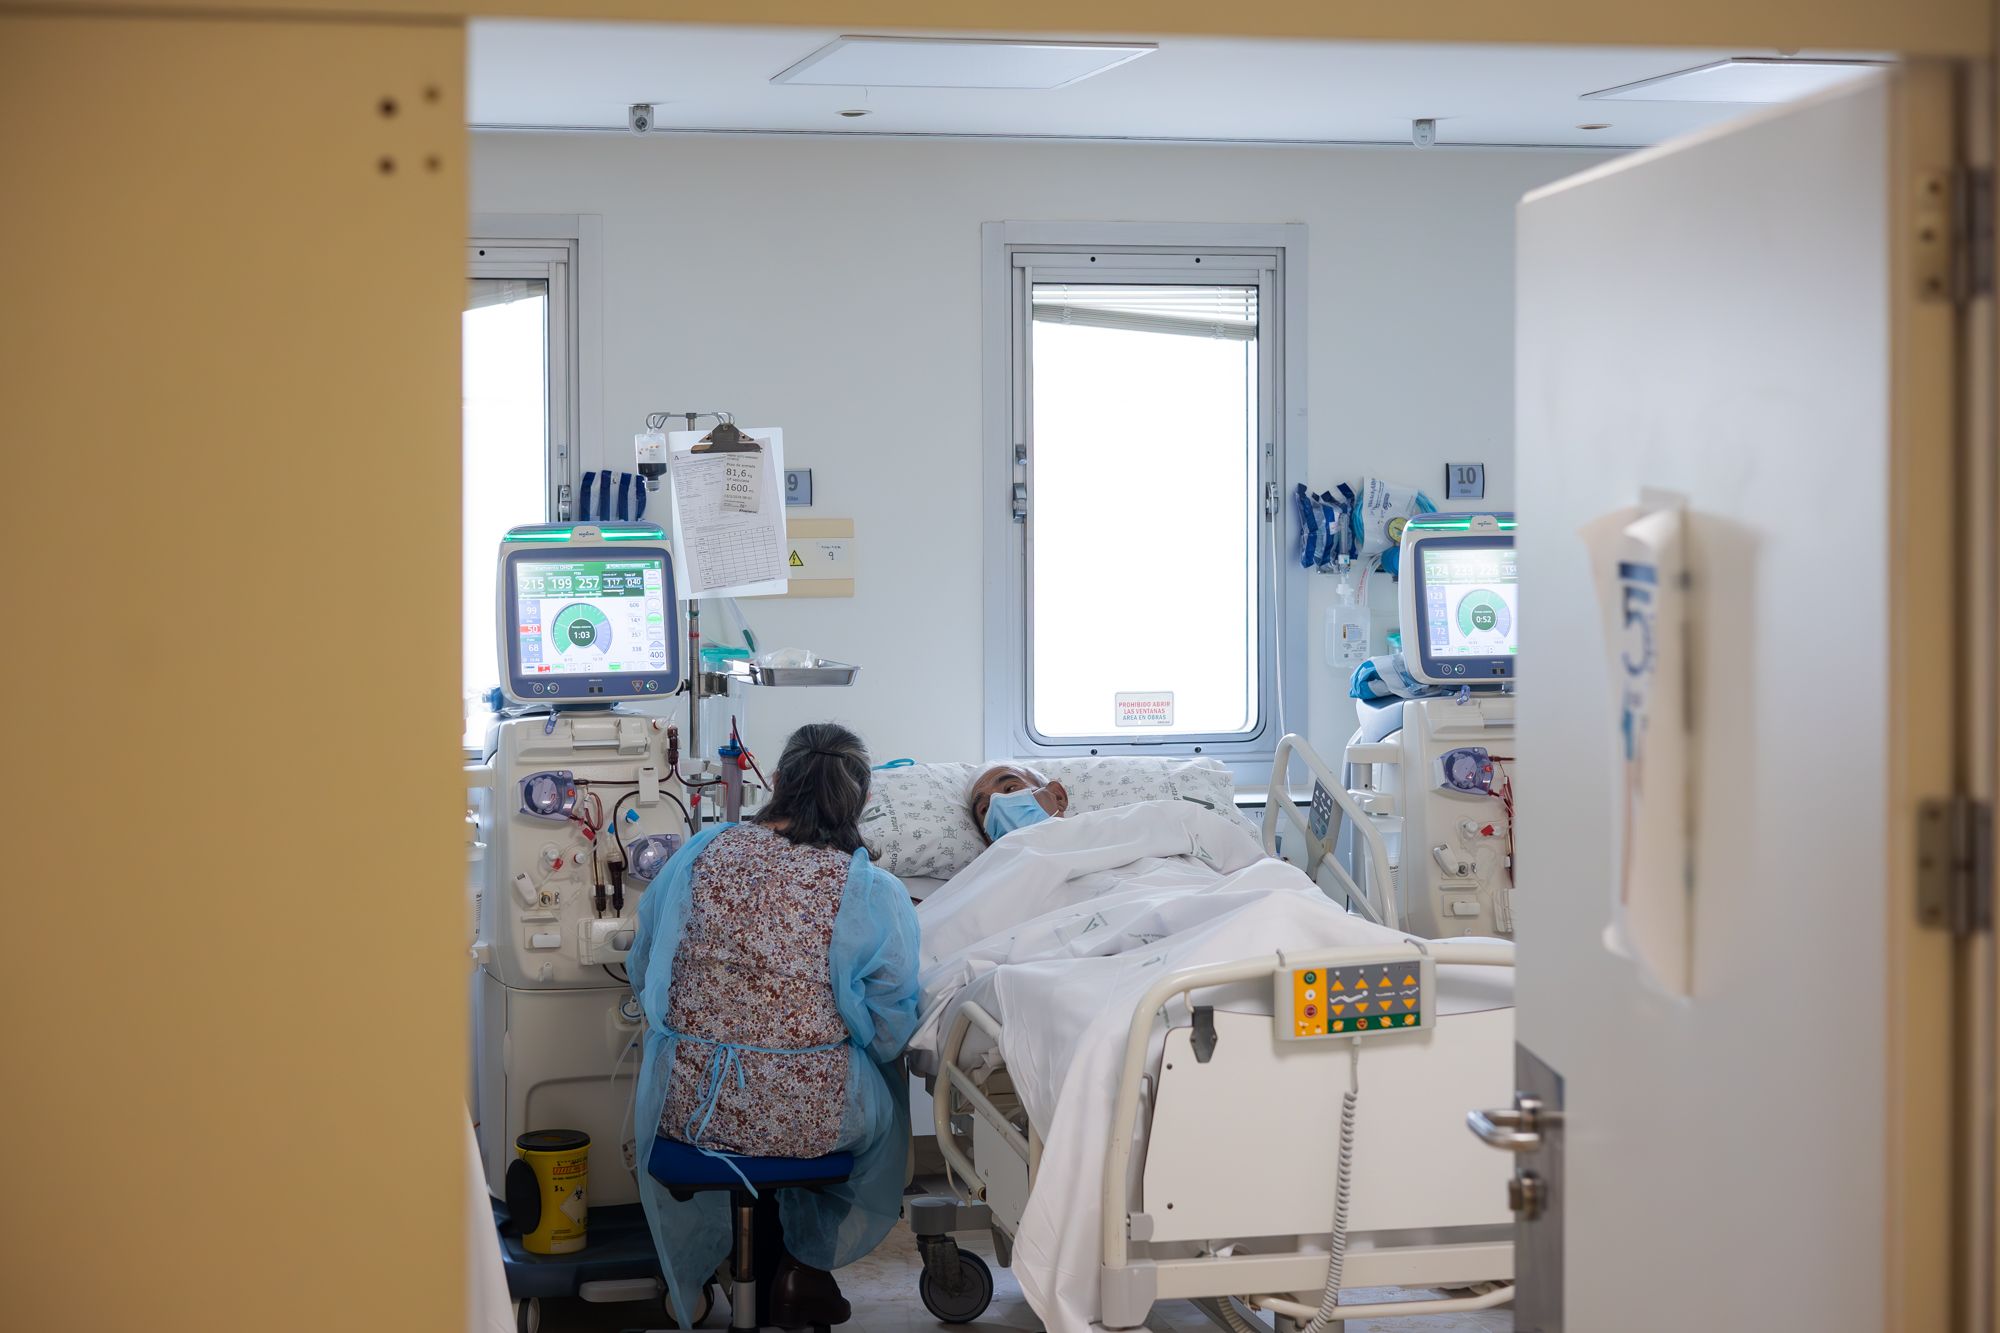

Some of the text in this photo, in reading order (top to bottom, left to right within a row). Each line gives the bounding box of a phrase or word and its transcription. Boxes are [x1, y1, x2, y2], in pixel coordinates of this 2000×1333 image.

[726, 468, 746, 477] 81,6
[1457, 467, 1476, 484] 10
[787, 473, 798, 491] 9
[726, 483, 748, 492] 1600
[552, 579, 572, 589] 199
[579, 578, 599, 588] 257
[526, 607, 537, 615] 99
[574, 631, 590, 639] 1:03
[528, 644, 539, 652] 68
